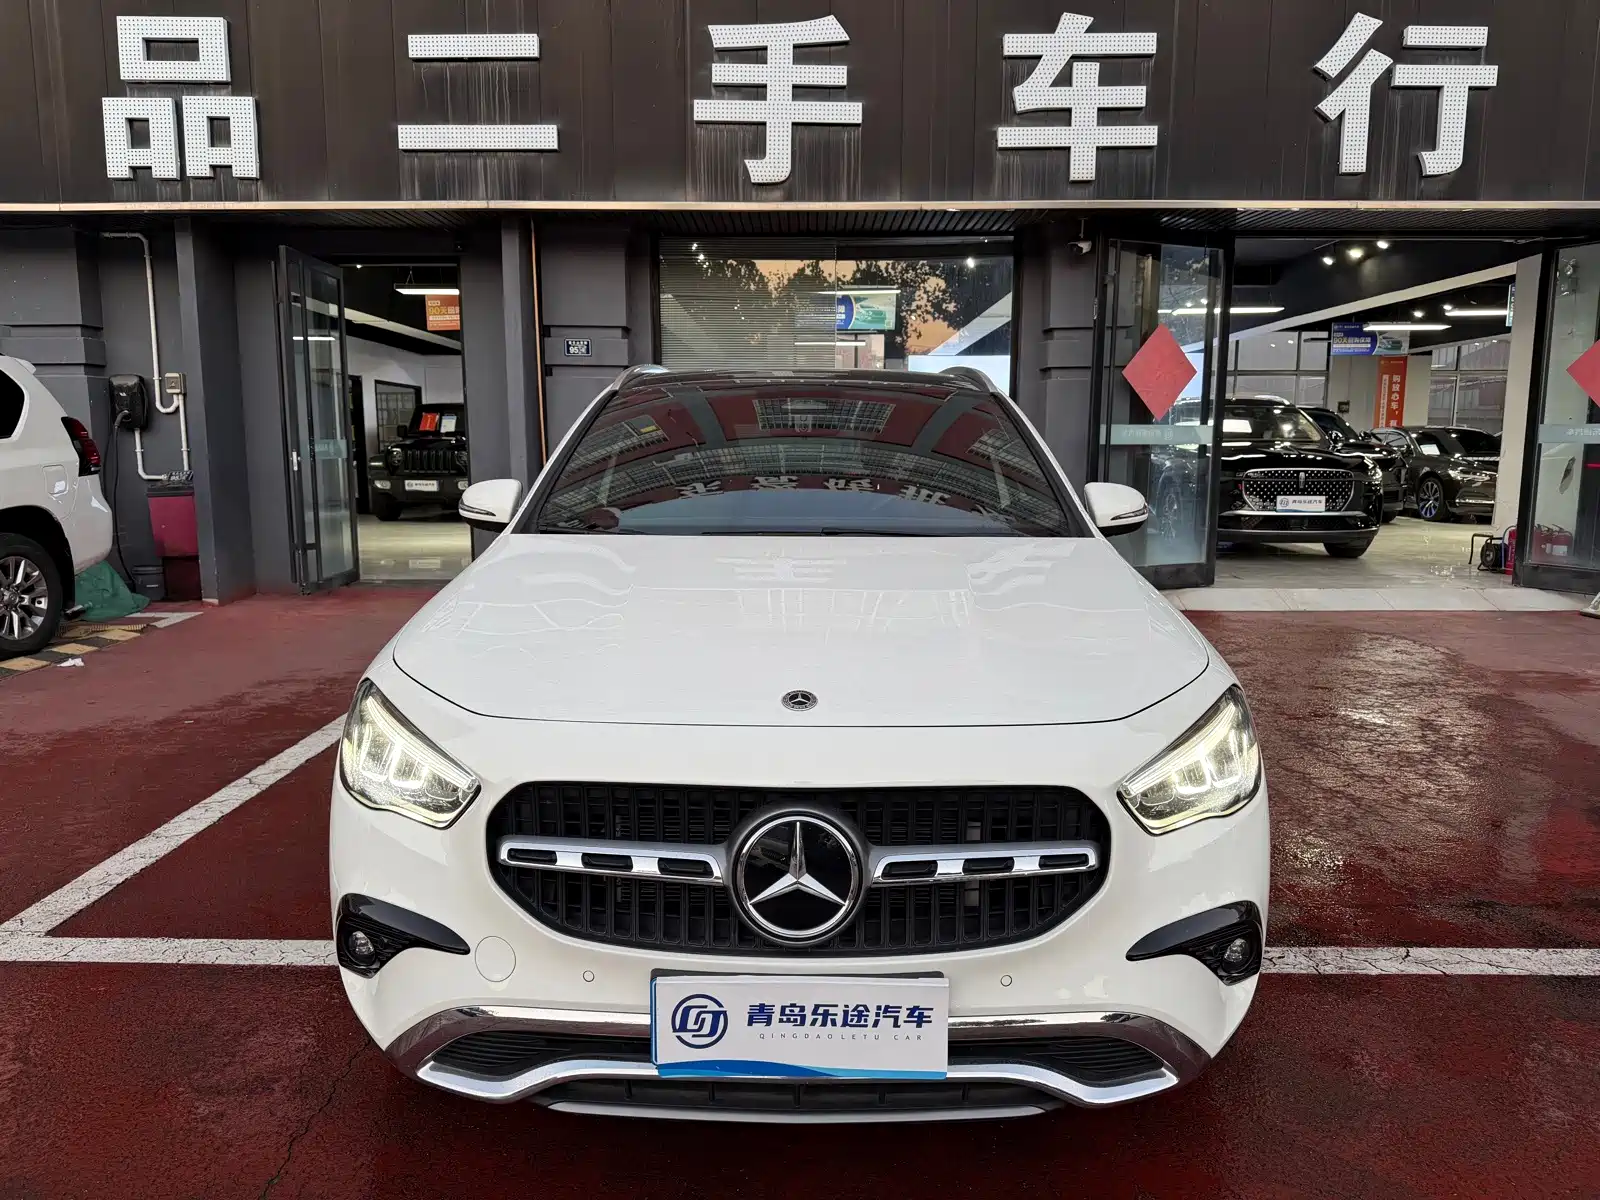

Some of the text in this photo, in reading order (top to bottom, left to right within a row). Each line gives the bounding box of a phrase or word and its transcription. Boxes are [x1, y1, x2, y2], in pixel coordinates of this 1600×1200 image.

[747, 1002, 934, 1029] 青岛乐途汽车
[759, 1033, 880, 1041] QINGDAOLETU
